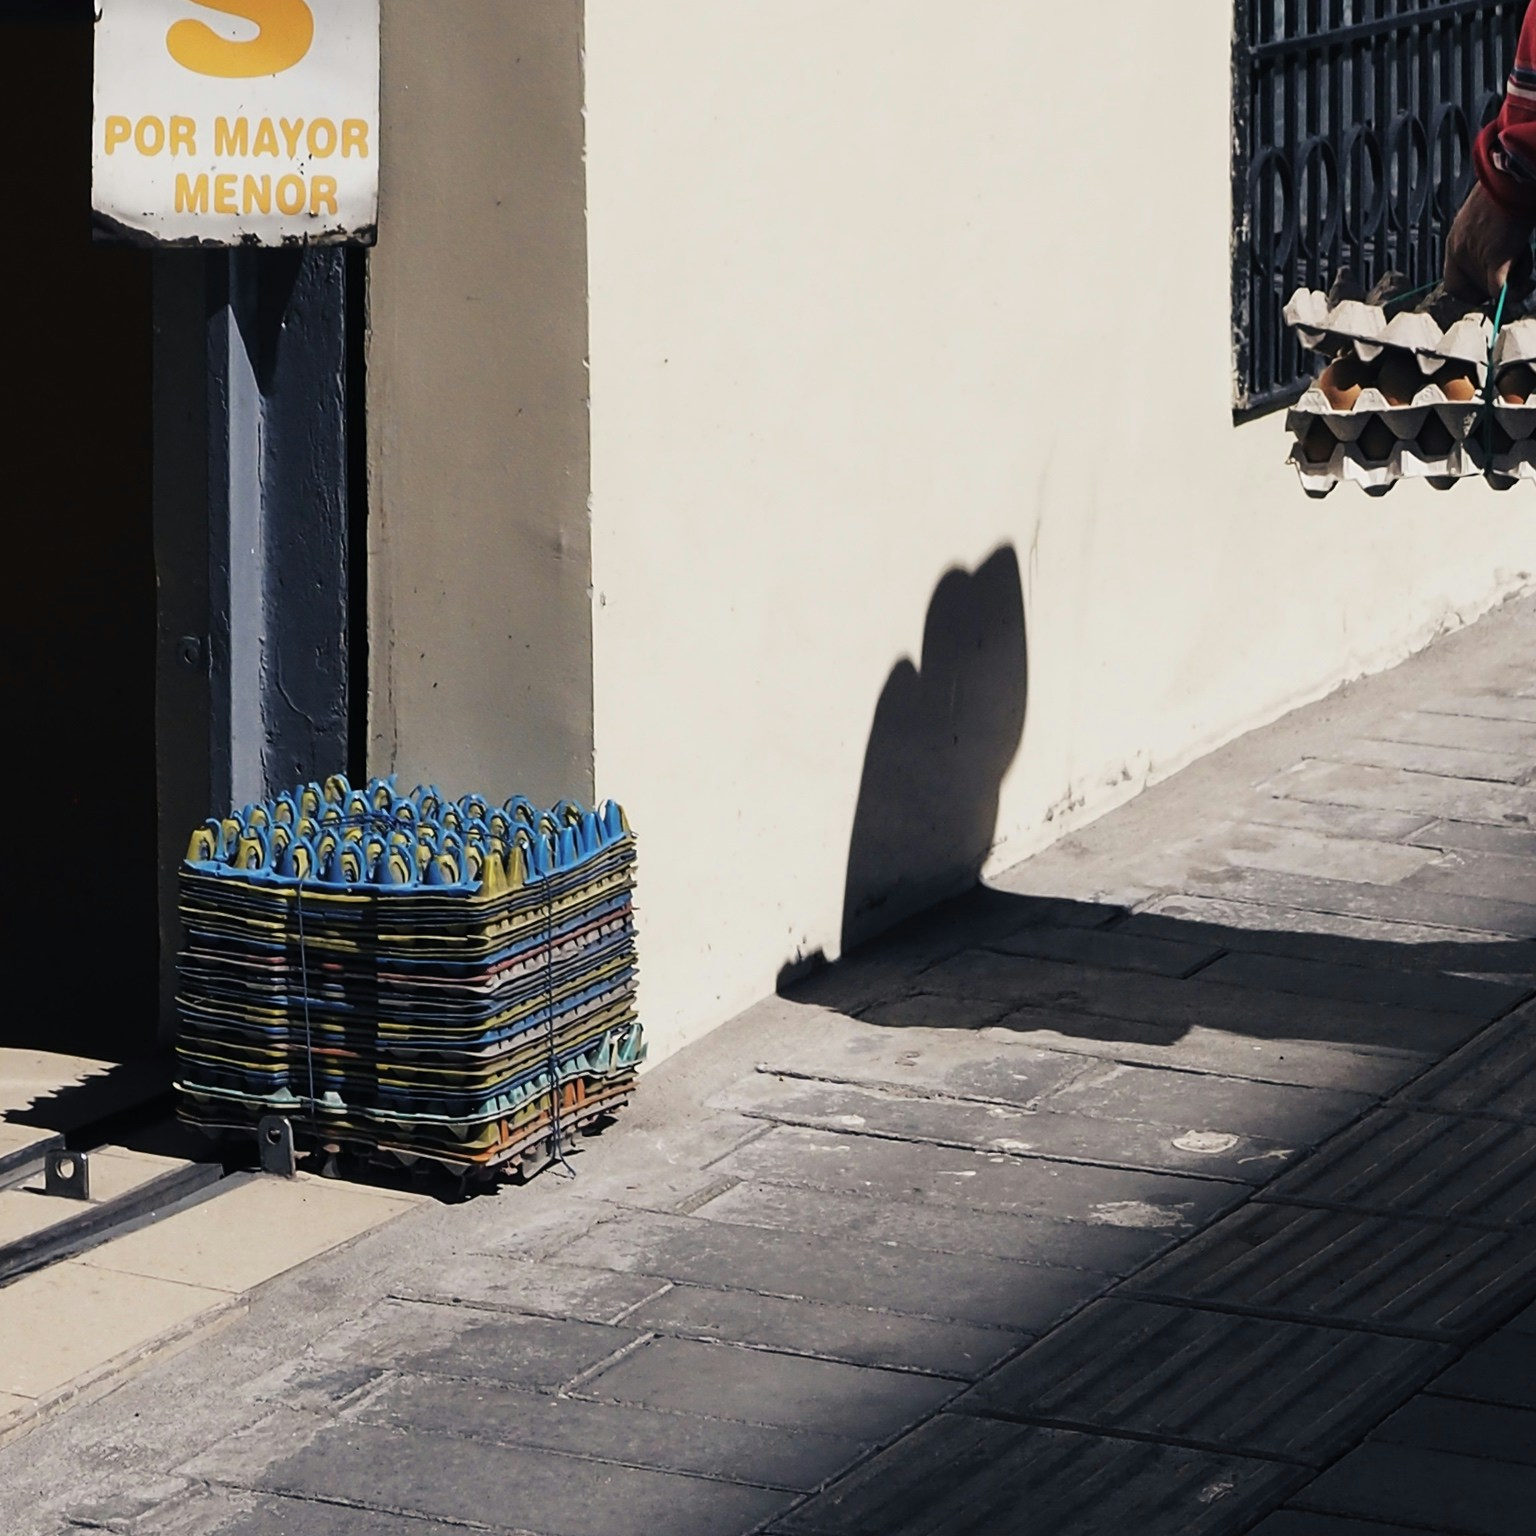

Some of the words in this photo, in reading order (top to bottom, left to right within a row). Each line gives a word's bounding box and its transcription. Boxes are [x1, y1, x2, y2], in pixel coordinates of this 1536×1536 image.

[104, 115, 197, 157] POR
[214, 116, 369, 159] MAYOR
[174, 172, 339, 216] MENOR
